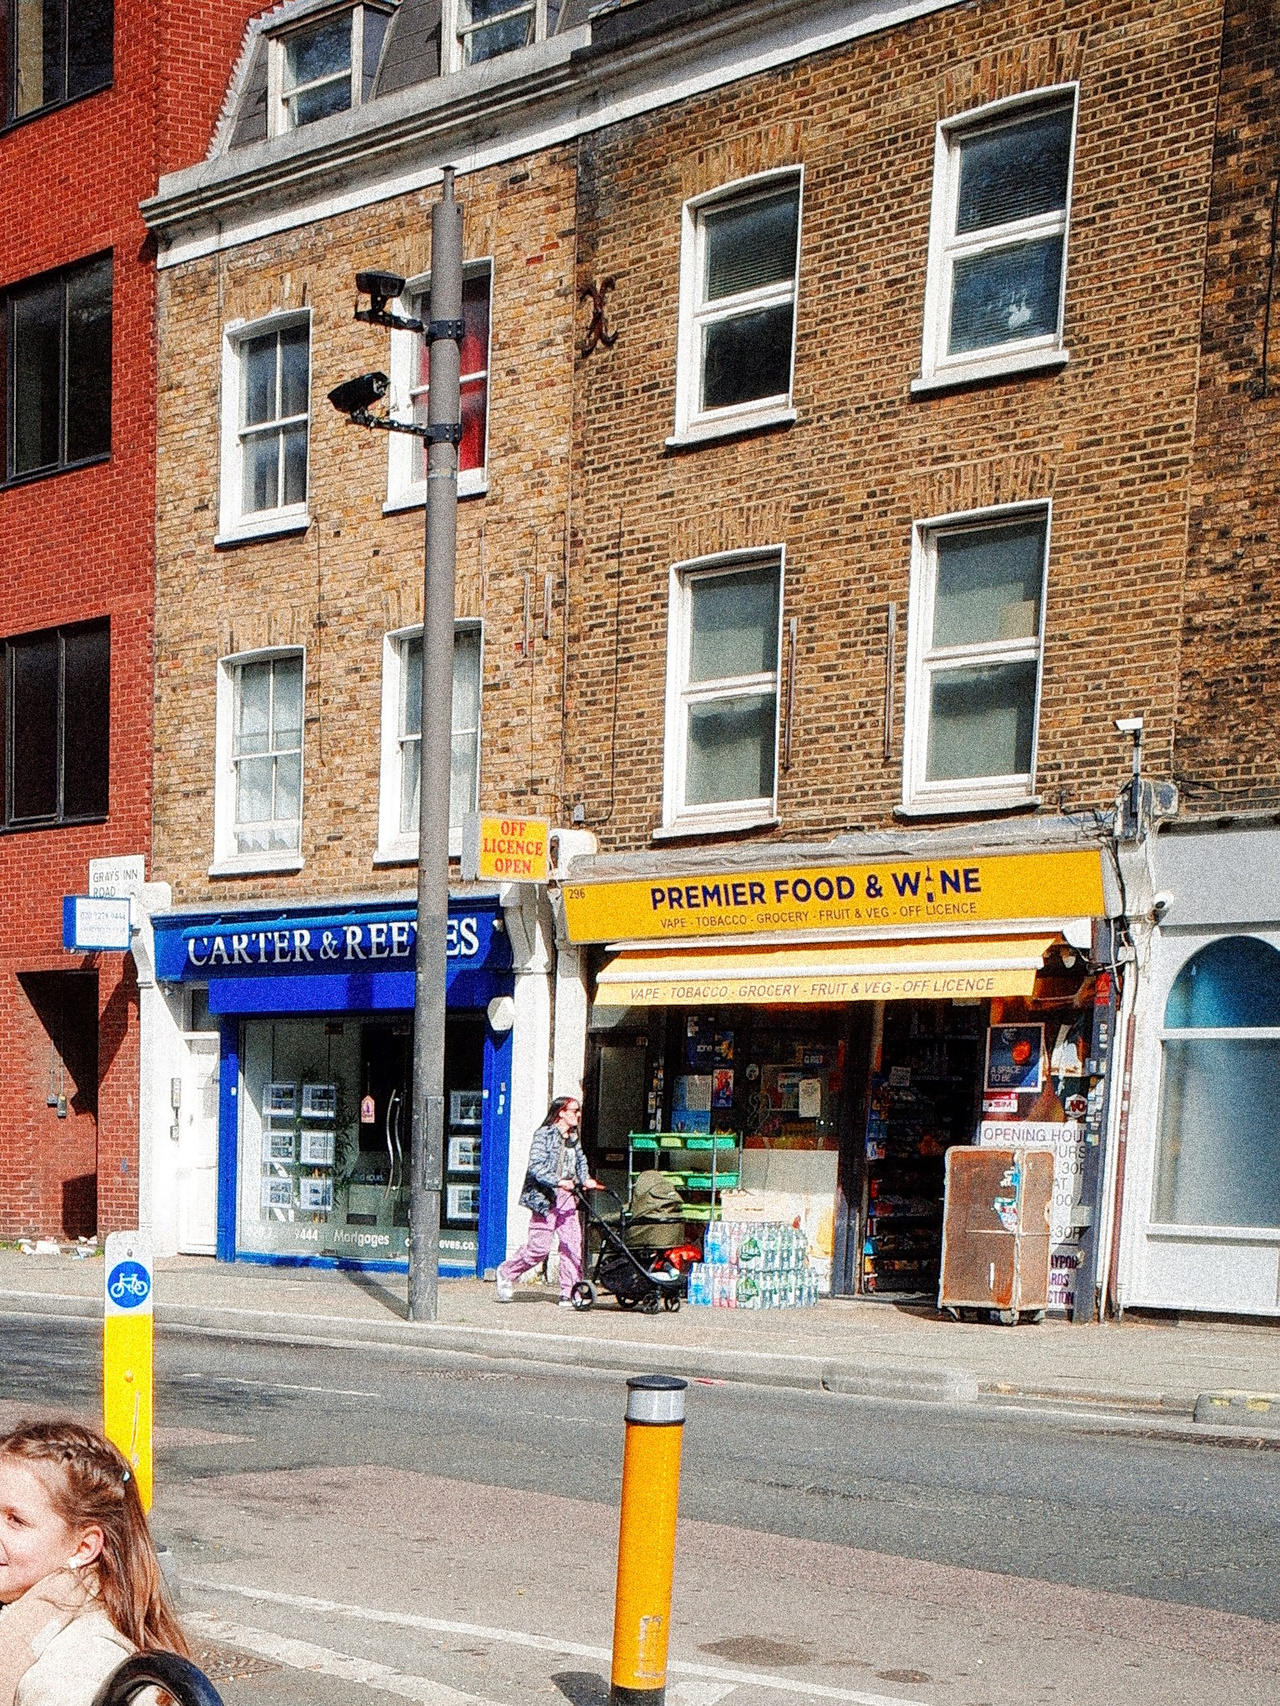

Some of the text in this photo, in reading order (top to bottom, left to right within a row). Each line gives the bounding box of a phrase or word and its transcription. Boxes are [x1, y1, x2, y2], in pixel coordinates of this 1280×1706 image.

[500, 821, 528, 836] OFF
[483, 838, 544, 856] LICENCE
[494, 858, 532, 874] OPEN
[123, 868, 139, 881] INN
[93, 886, 117, 897] ROAD
[568, 888, 586, 899] 296
[650, 880, 767, 910] PREMIER
[774, 875, 855, 903] FOOD
[865, 874, 883, 899] &
[661, 917, 687, 929] VAPE
[696, 914, 747, 927] TOBACCO
[756, 911, 809, 924] GROCERY
[819, 908, 850, 921] FRUIT
[854, 908, 862, 919] &
[866, 906, 889, 918] VEG
[899, 905, 921, 917] OFF
[926, 902, 977, 916] LICENCE
[187, 928, 314, 967] CARTER
[320, 931, 340, 960] &
[629, 987, 660, 999] VAPE
[670, 986, 728, 998] TOBACCO
[738, 984, 799, 997] GROCERY
[810, 983, 848, 995] FRUIT
[851, 982, 860, 993] &
[864, 981, 892, 994] VEG
[902, 980, 932, 993] OFF
[933, 978, 995, 992] LICENCE
[990, 1074, 1001, 1082] TO
[999, 1065, 1021, 1075] SPACE
[983, 1127, 1086, 1144] OPENING HOU
[1057, 1144, 1086, 1160] URS
[333, 1229, 390, 1247] Mortgages
